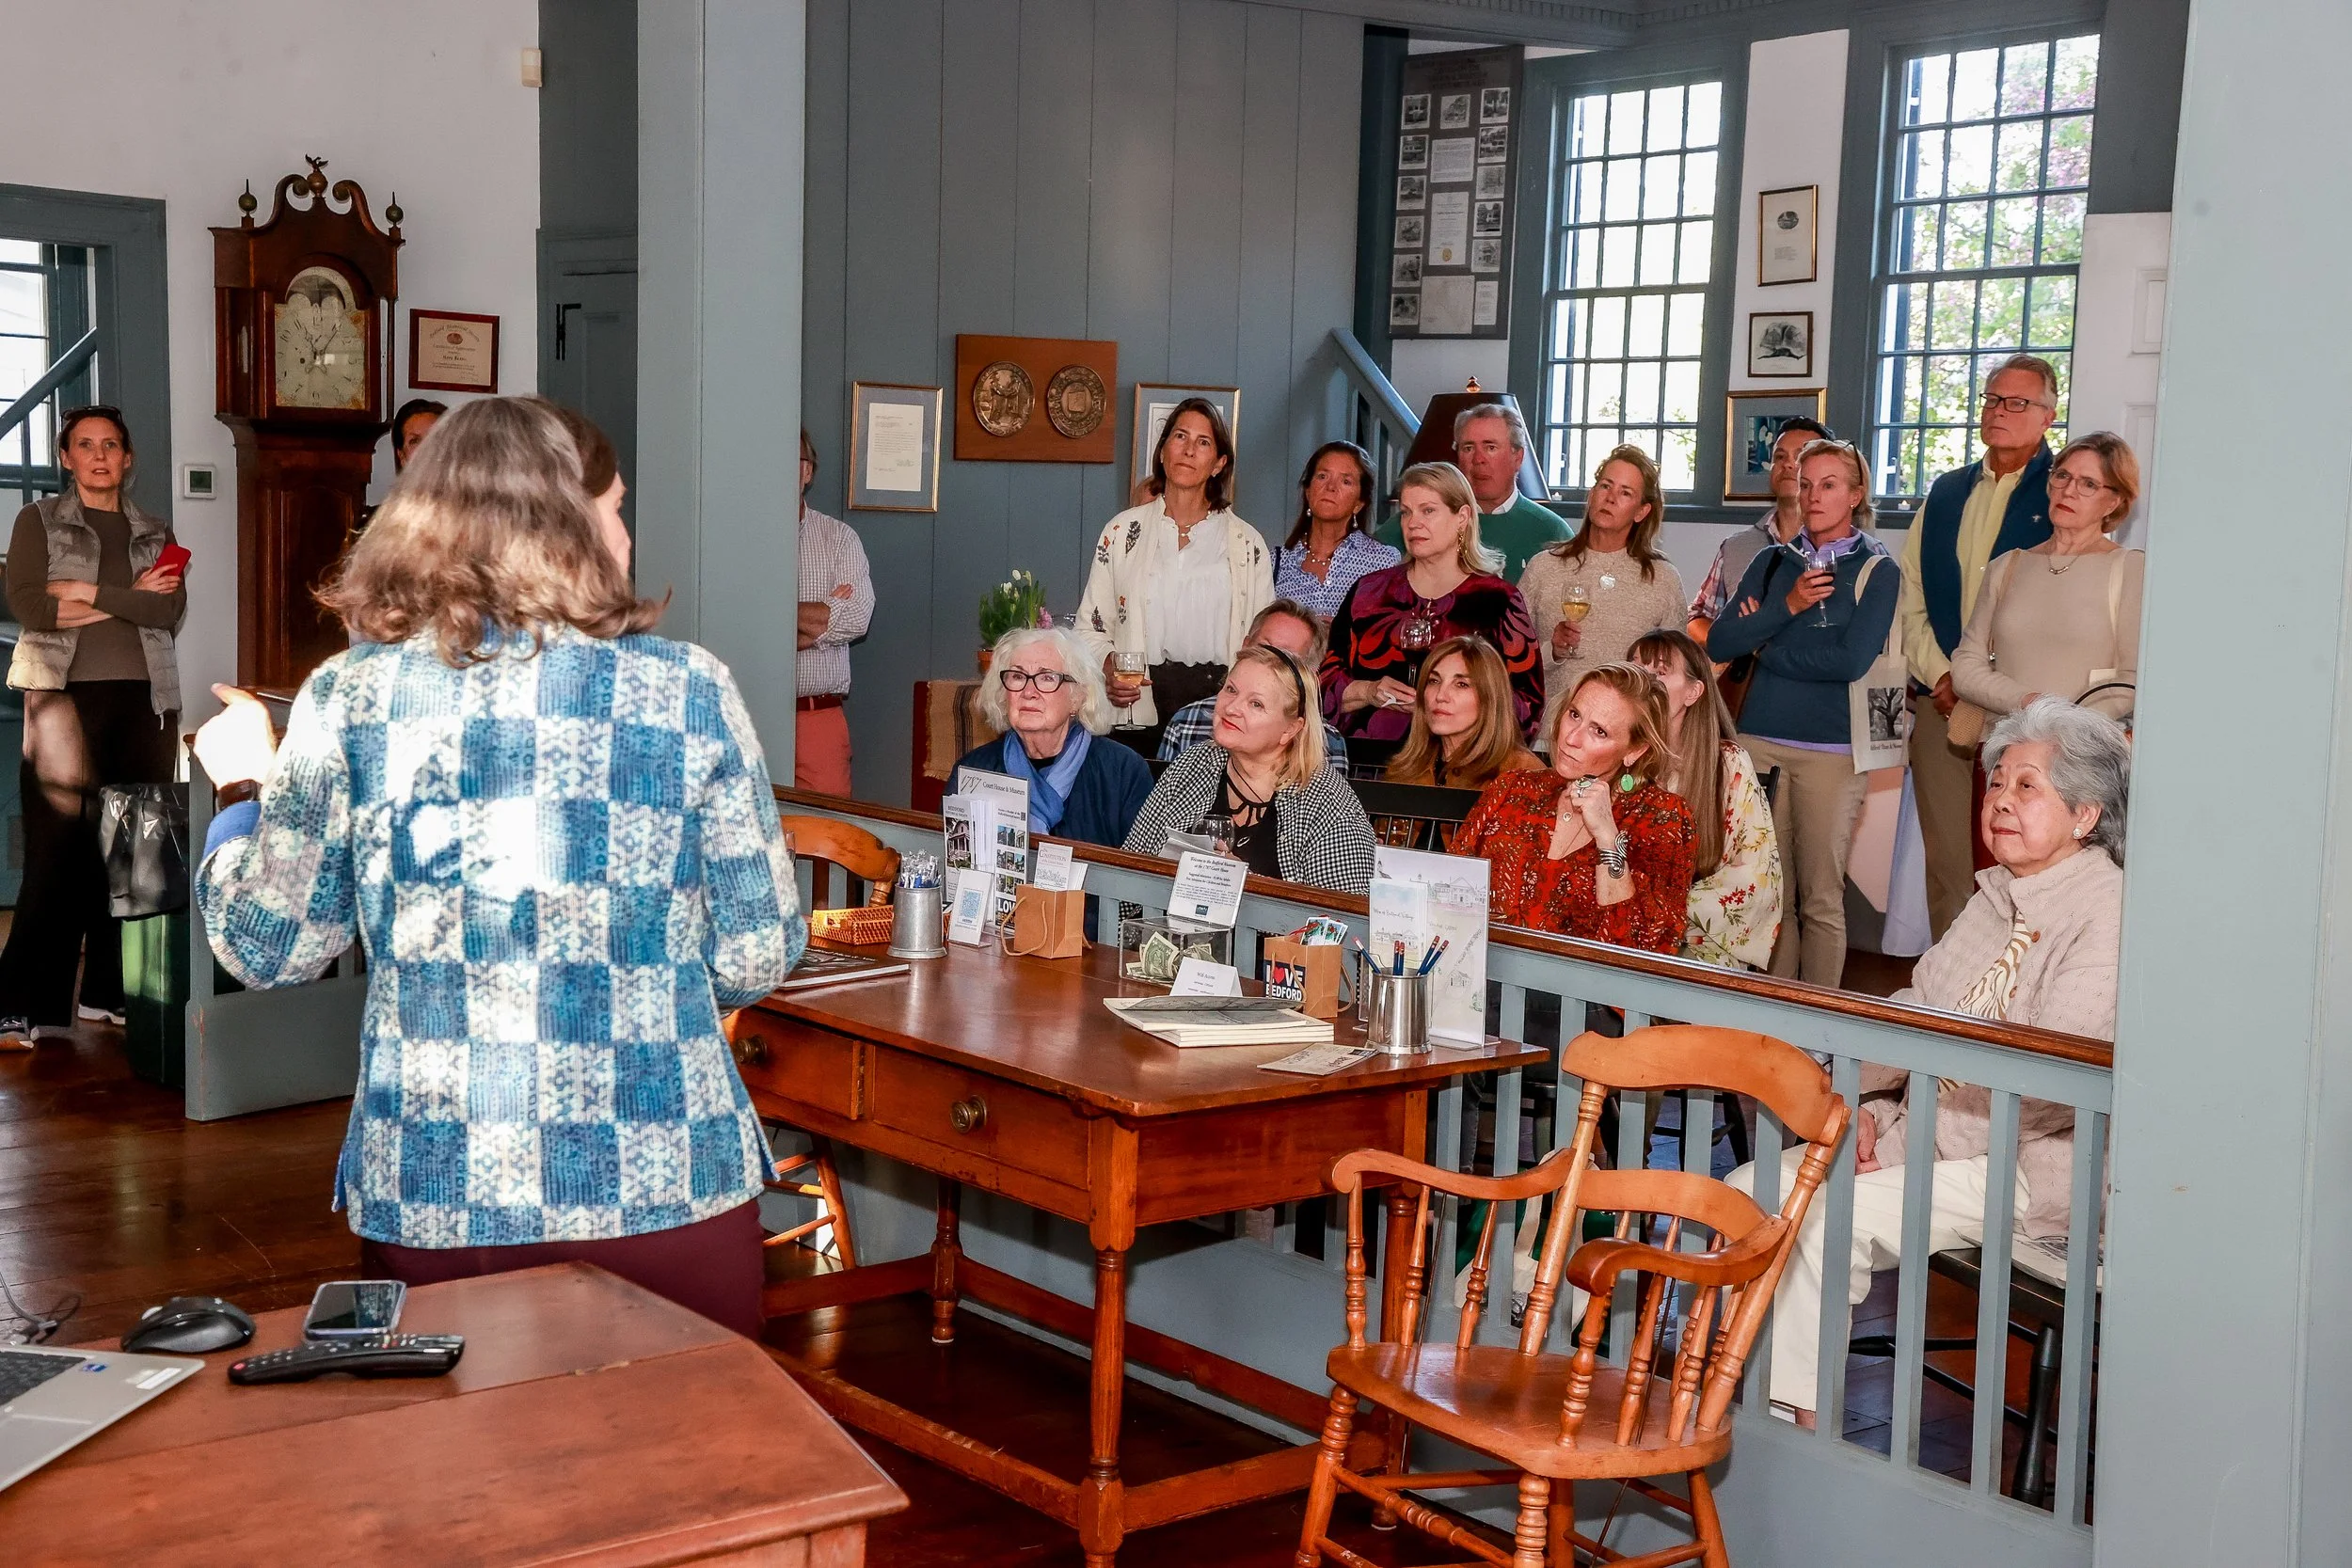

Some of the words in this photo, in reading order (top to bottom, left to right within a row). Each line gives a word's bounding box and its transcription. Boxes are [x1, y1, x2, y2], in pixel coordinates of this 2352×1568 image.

[961, 774, 982, 794] 1787
[982, 781, 994, 790] Court
[993, 783, 1006, 792] House
[1009, 786, 1025, 796] Museum
[997, 898, 1016, 913] LOV
[1265, 983, 1303, 1002] BEDFORD
